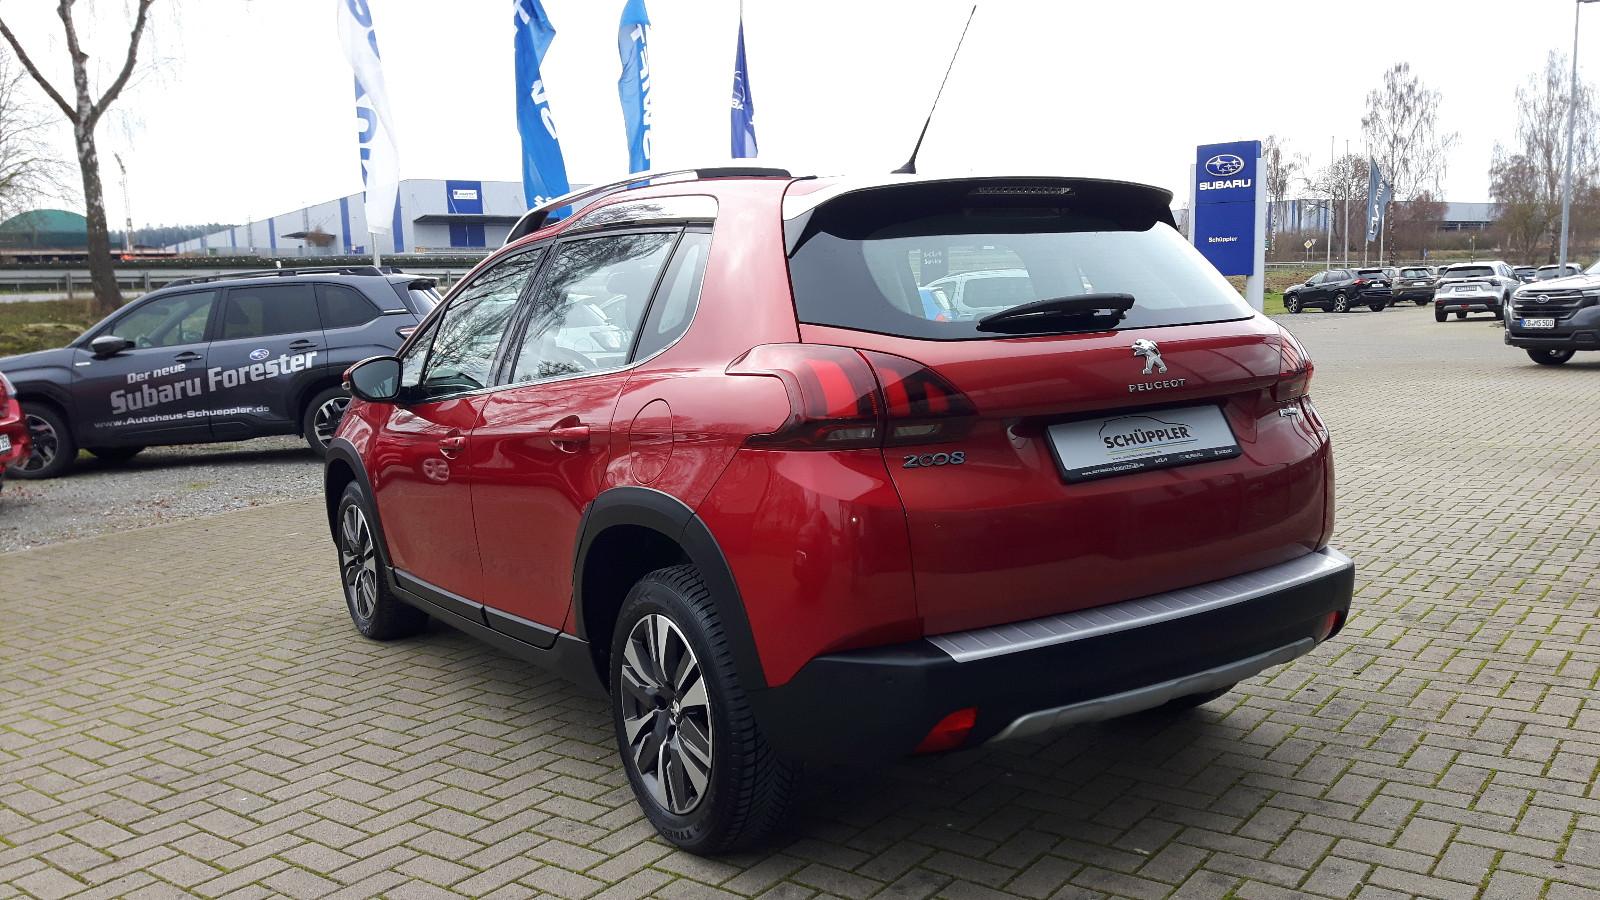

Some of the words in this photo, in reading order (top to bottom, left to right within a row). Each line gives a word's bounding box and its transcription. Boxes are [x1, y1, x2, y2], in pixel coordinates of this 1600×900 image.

[1199, 179, 1252, 190] SUBARU
[110, 376, 201, 414] Subaru
[208, 351, 318, 392] Forester
[127, 371, 150, 384] Der
[153, 363, 186, 378] neue
[1128, 378, 1186, 393] PEUGEOT
[1104, 426, 1191, 449] SCHÜPPLER
[903, 451, 965, 468] 2008
